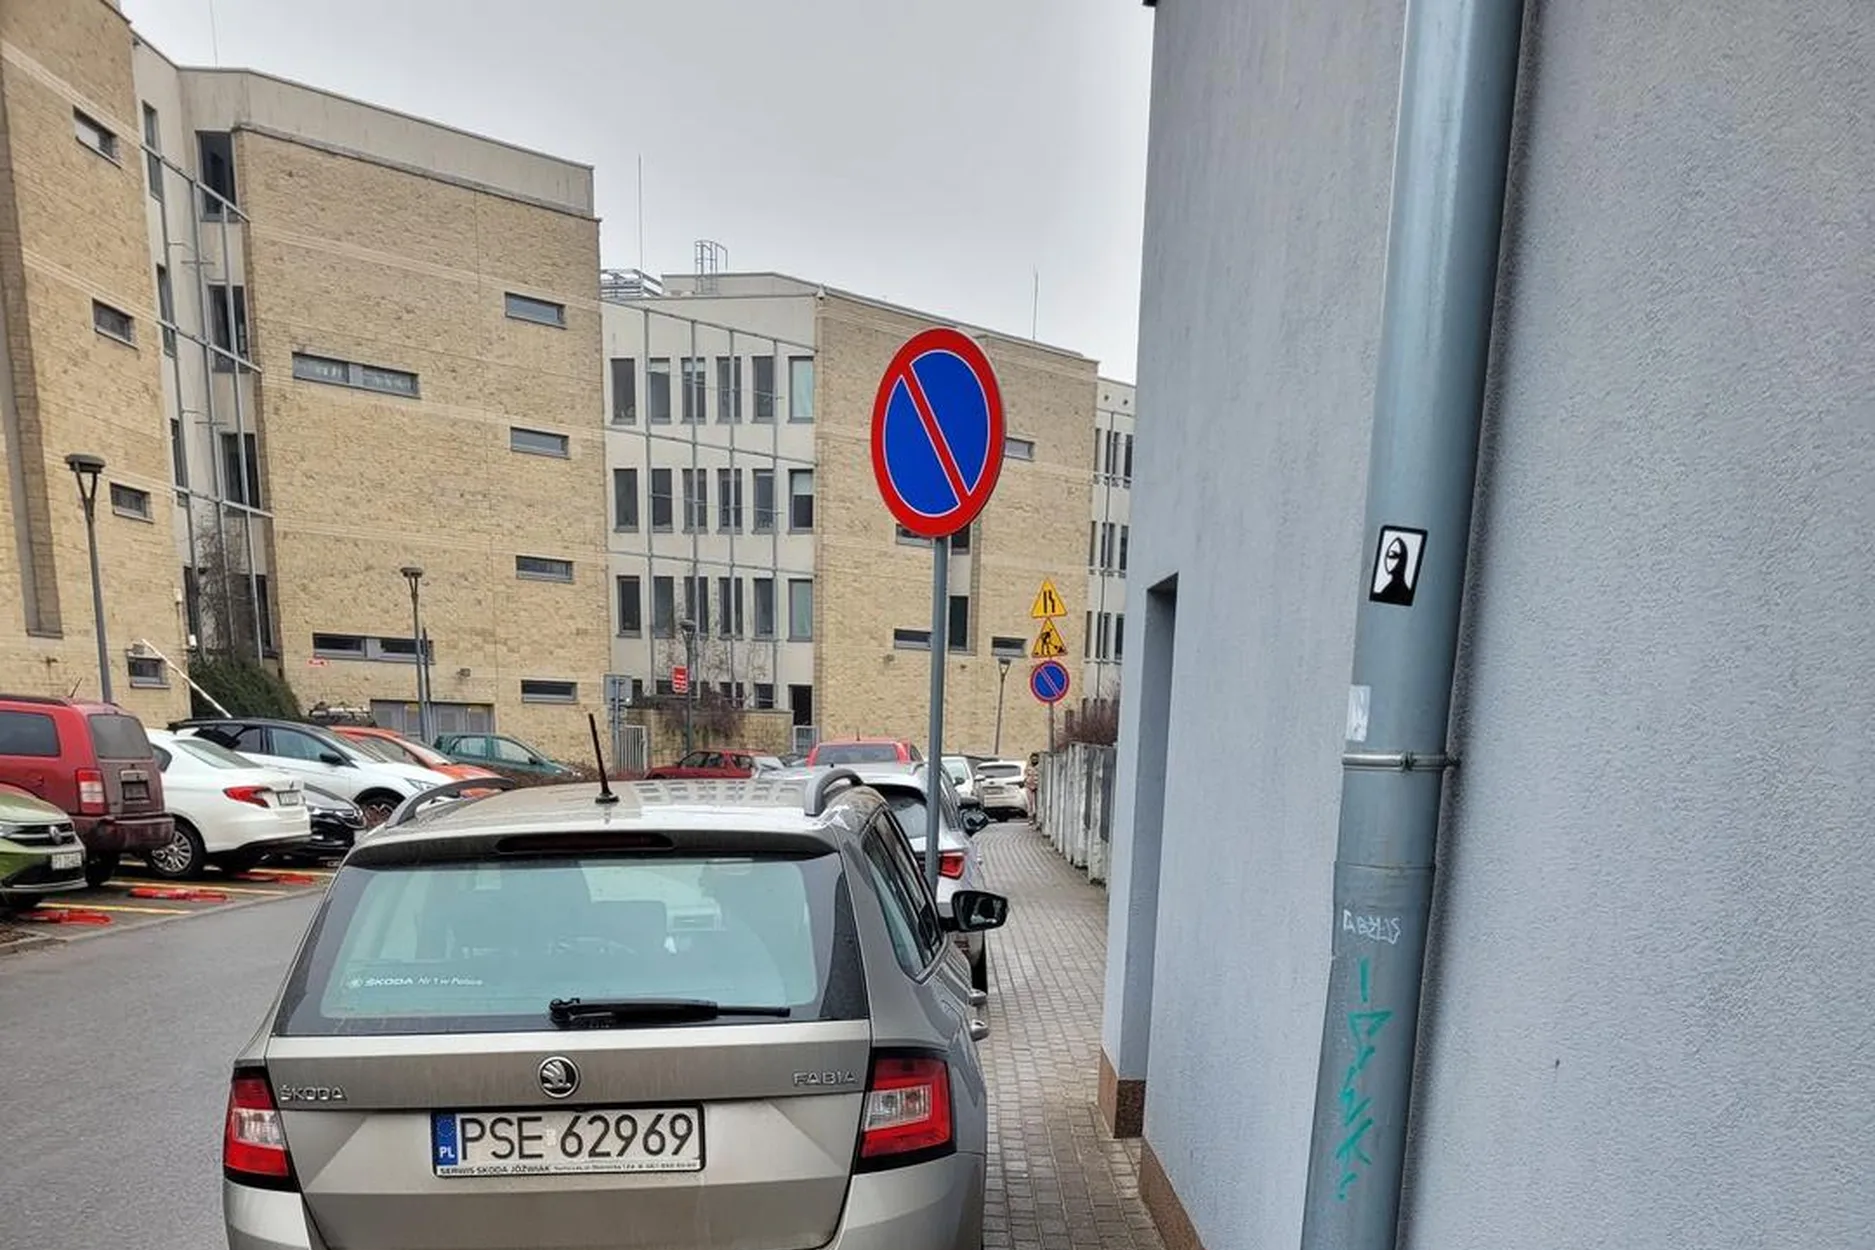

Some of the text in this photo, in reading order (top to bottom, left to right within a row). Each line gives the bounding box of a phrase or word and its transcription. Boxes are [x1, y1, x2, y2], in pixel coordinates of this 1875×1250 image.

[793, 1070, 860, 1085] FABIA
[460, 1112, 694, 1161] PSE 62969
[439, 1146, 456, 1159] PL
[440, 1166, 475, 1175] SERWIS
